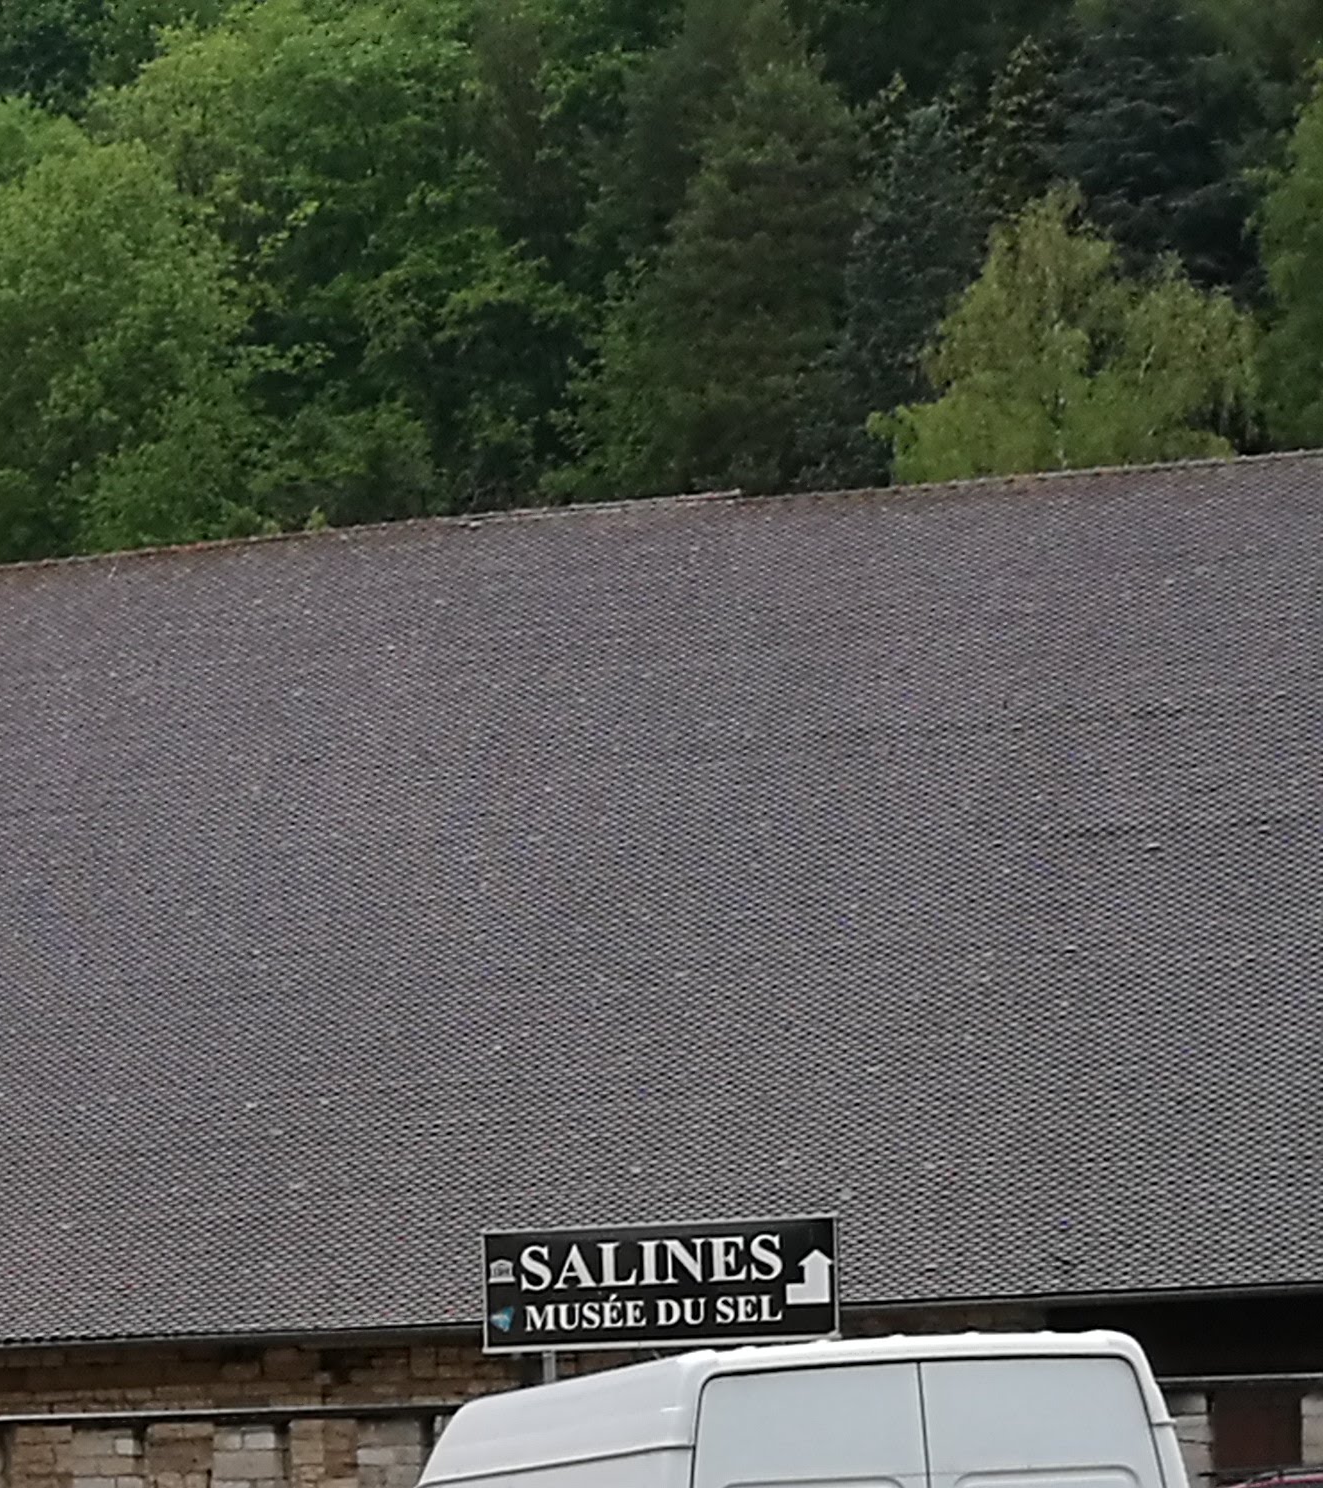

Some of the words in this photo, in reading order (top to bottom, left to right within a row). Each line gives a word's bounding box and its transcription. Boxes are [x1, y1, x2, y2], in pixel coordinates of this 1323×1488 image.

[520, 1233, 783, 1291] SALINES
[524, 1293, 647, 1332] MUSÉE
[655, 1296, 707, 1326] DU
[715, 1294, 783, 1324] SEL
